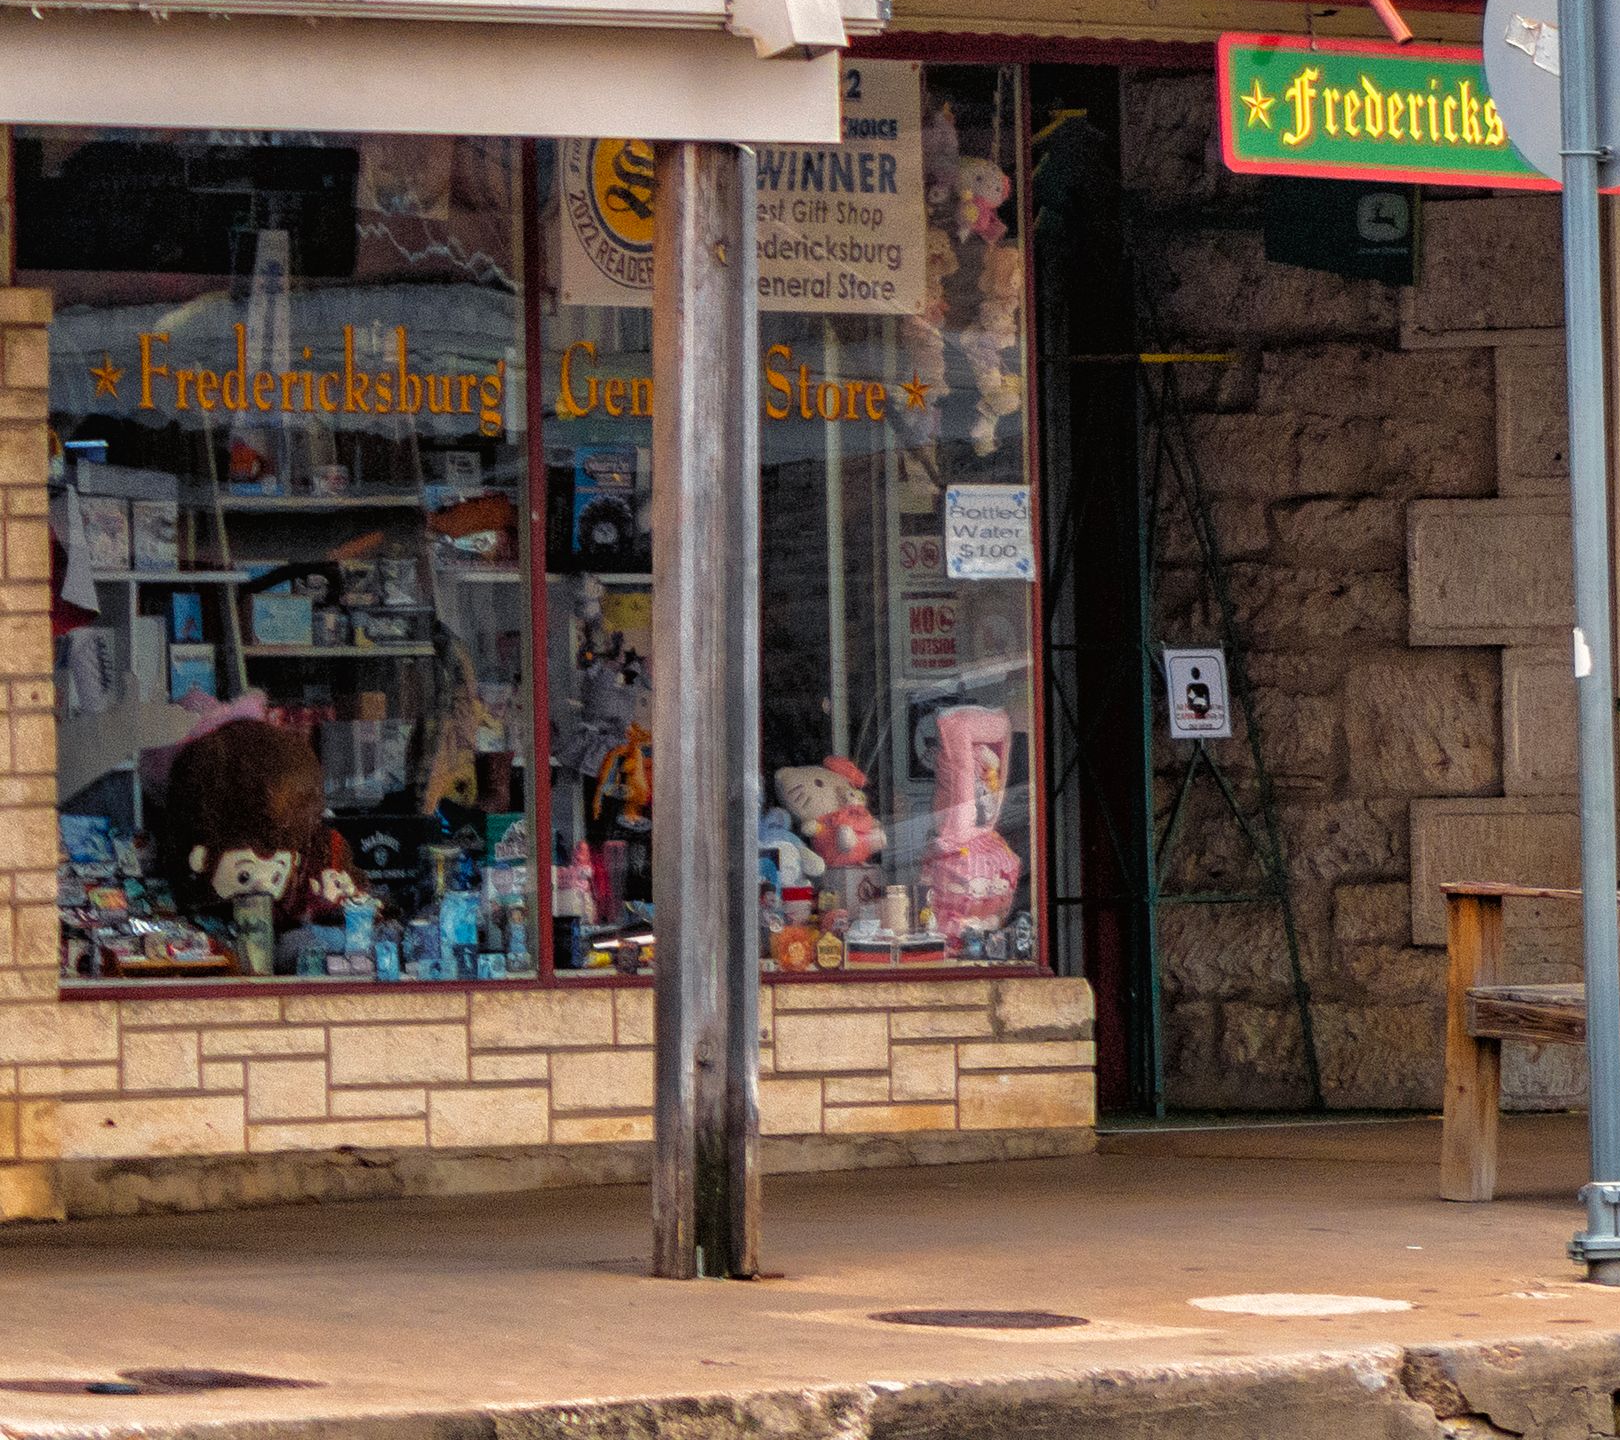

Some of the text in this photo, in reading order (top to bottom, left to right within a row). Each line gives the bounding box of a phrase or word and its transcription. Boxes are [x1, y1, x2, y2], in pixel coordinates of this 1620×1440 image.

[1282, 66, 1510, 146] Fredericks
[757, 150, 898, 194] WINNER
[757, 200, 883, 231] est Gift Shop
[757, 231, 902, 271] edericksburg
[758, 270, 896, 301] eneral Store
[137, 321, 508, 437] Fredericksburg
[765, 342, 887, 423] Store
[950, 504, 1028, 521] Bottled
[952, 524, 1024, 540] Water
